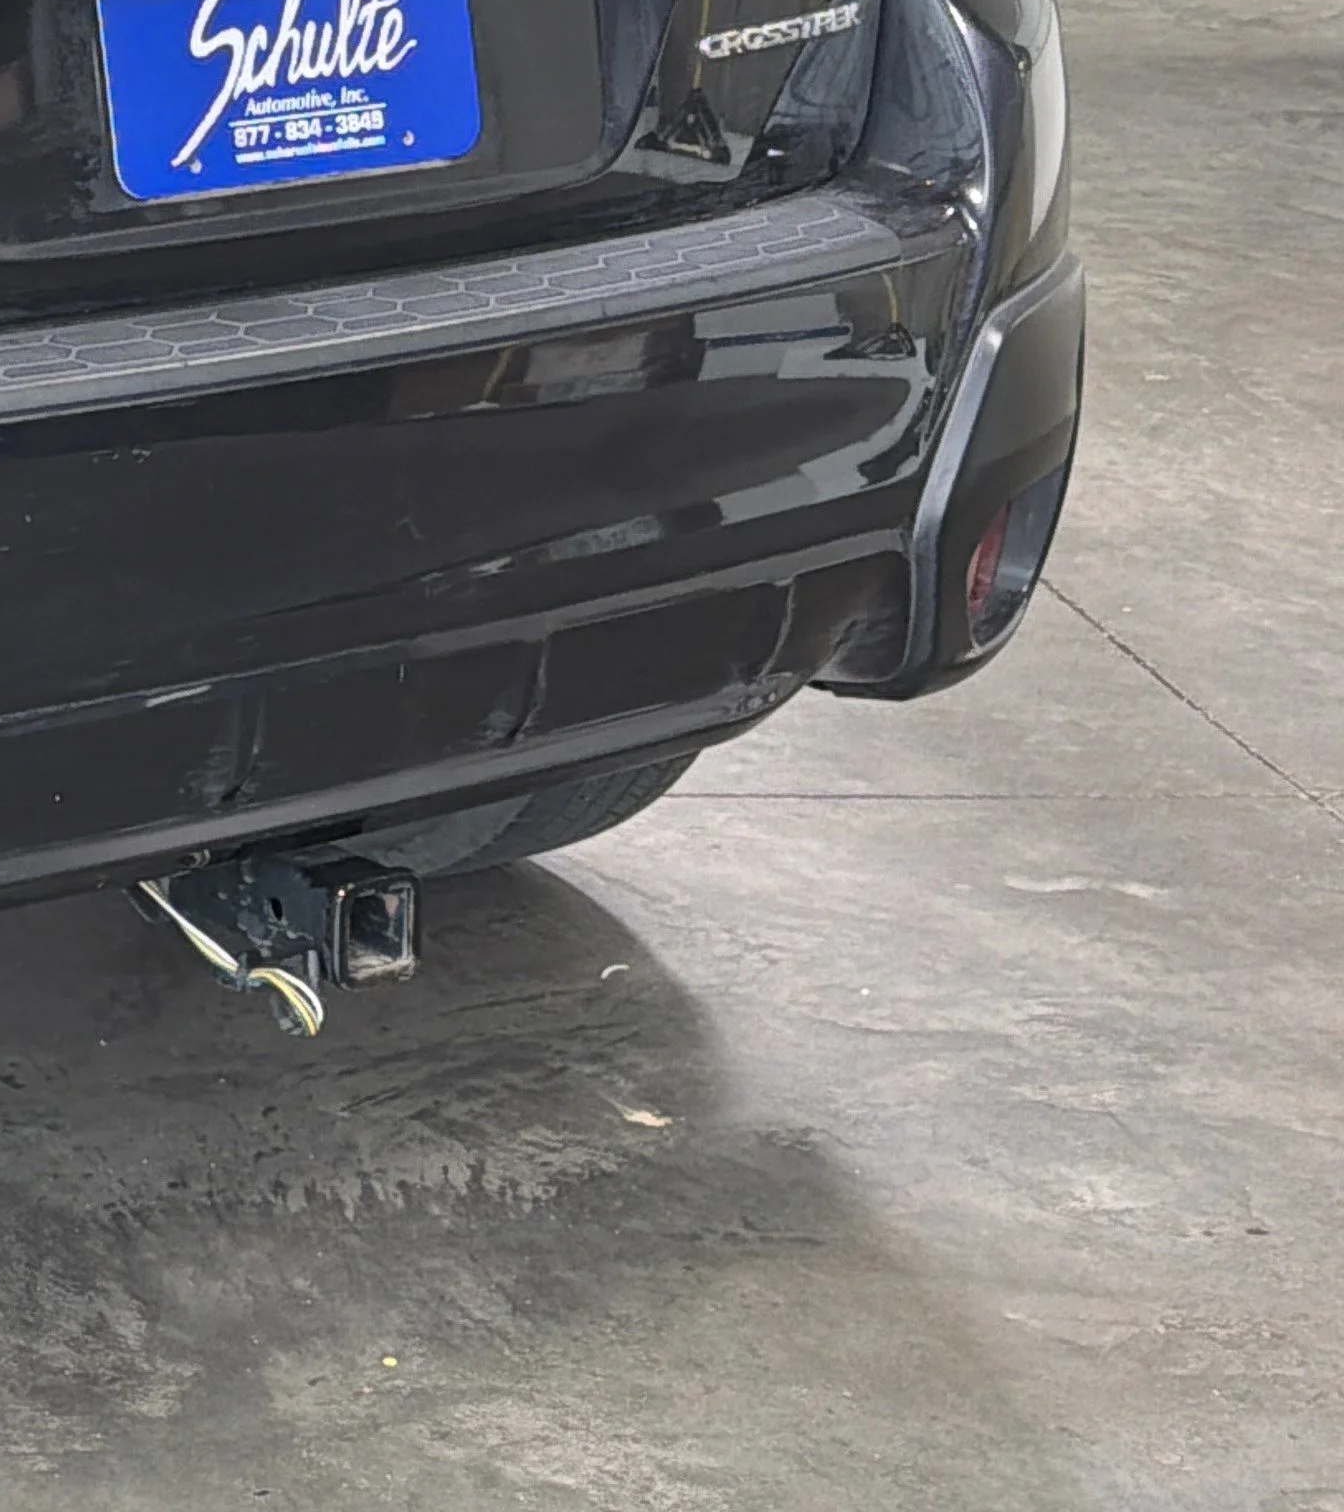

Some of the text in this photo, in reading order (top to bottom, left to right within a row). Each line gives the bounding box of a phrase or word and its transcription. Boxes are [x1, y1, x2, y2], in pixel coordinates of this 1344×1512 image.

[698, 1, 861, 59] CROSSTREK
[244, 85, 370, 117] Automotive, Inc.
